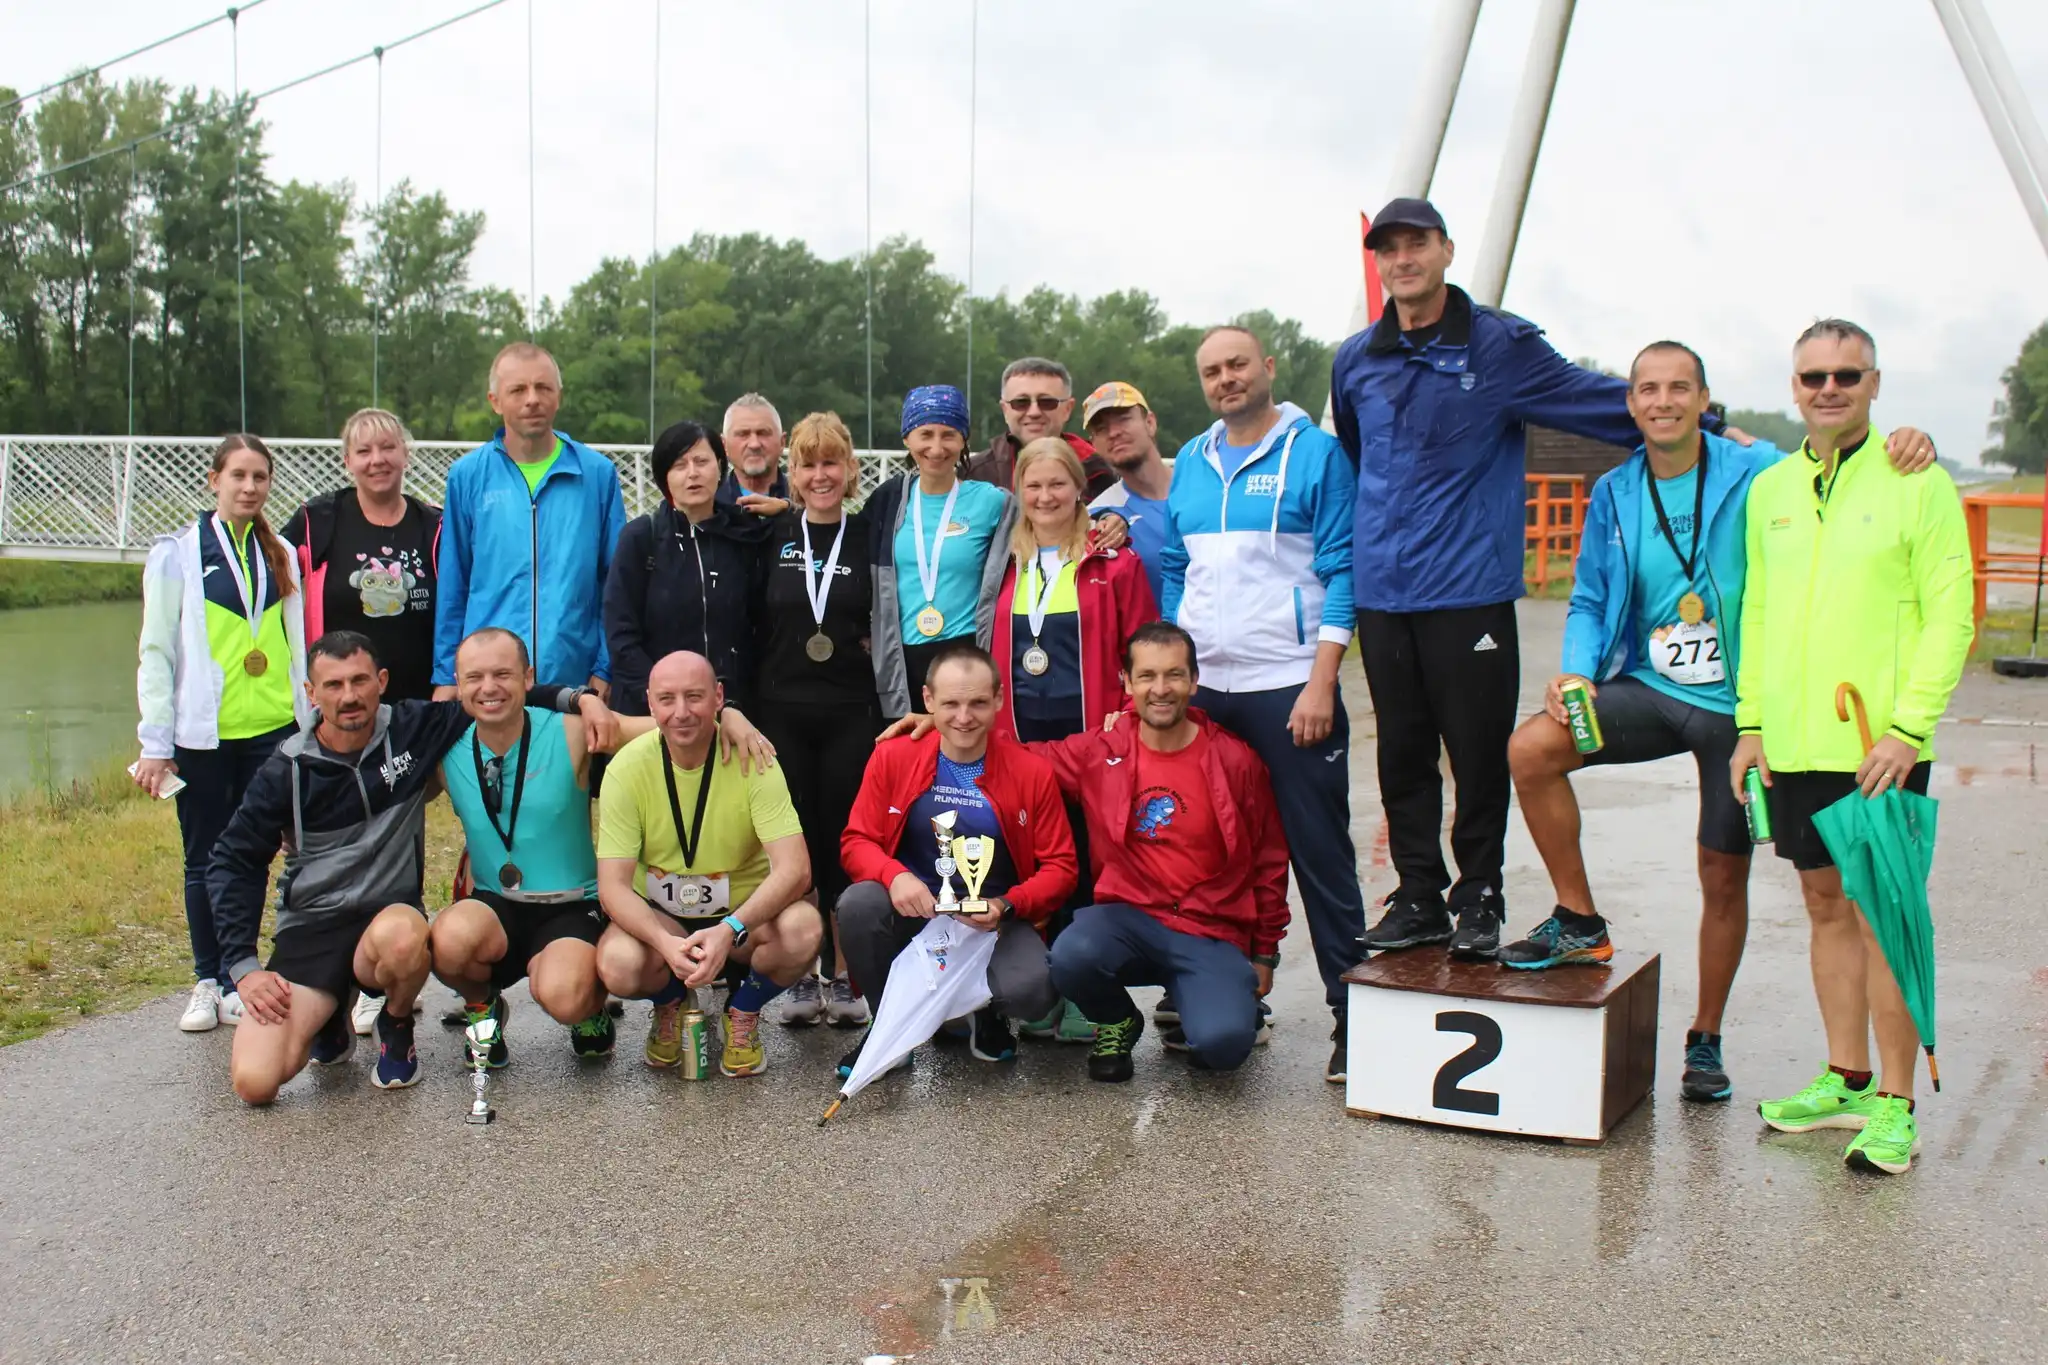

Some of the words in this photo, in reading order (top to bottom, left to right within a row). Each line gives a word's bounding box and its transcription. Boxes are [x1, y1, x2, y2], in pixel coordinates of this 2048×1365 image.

[410, 589, 429, 599] LISTEN
[1666, 637, 1721, 667] 272
[1567, 701, 1590, 740] PAN
[934, 794, 984, 808] RUNNERS
[661, 882, 713, 904] 13
[699, 1031, 709, 1067] PAN
[1432, 1011, 1503, 1116] 2
